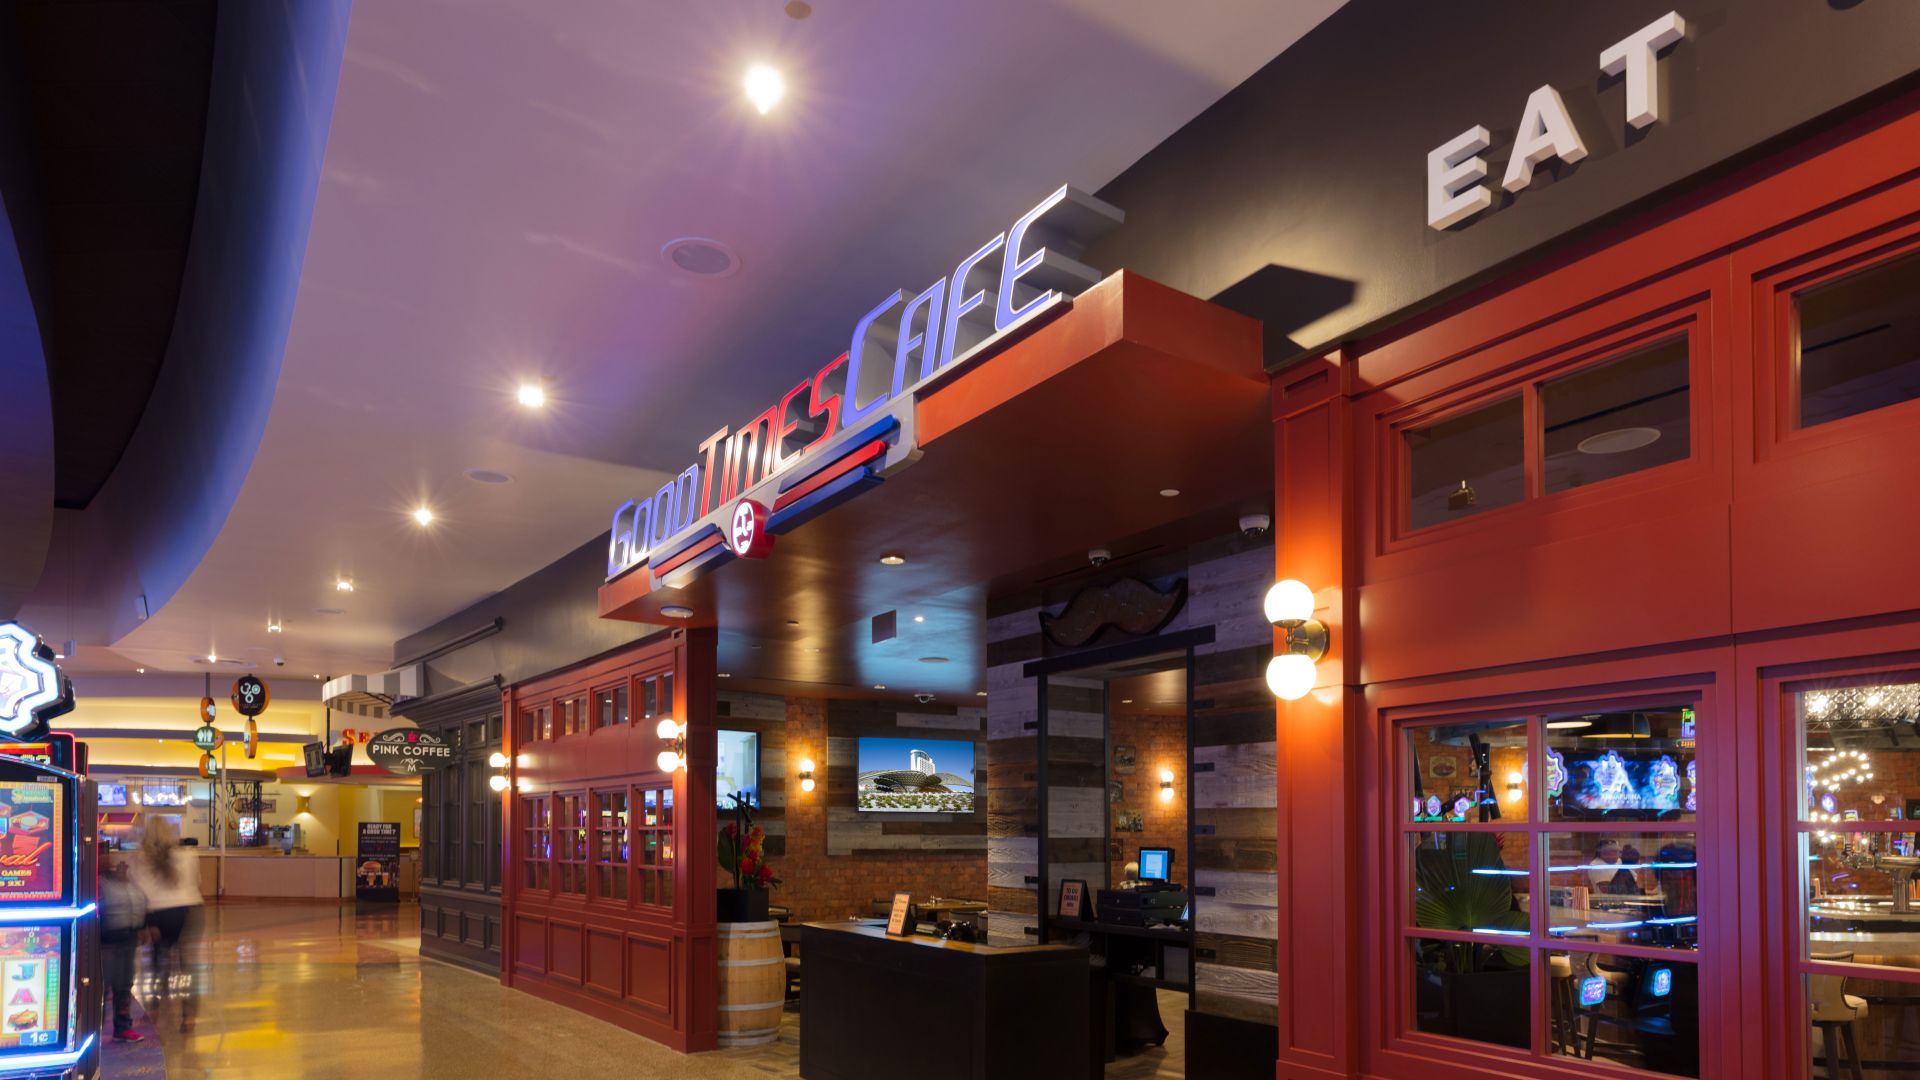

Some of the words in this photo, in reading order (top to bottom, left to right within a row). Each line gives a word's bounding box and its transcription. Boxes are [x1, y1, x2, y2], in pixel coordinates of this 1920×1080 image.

[1428, 10, 1685, 231] EAT
[607, 462, 699, 577] GOOD
[698, 349, 850, 519] TIMES
[841, 183, 1070, 428] CAFE
[372, 744, 400, 755] PINK
[402, 745, 451, 757] COFFEE
[30, 1032, 49, 1044] 1¢
